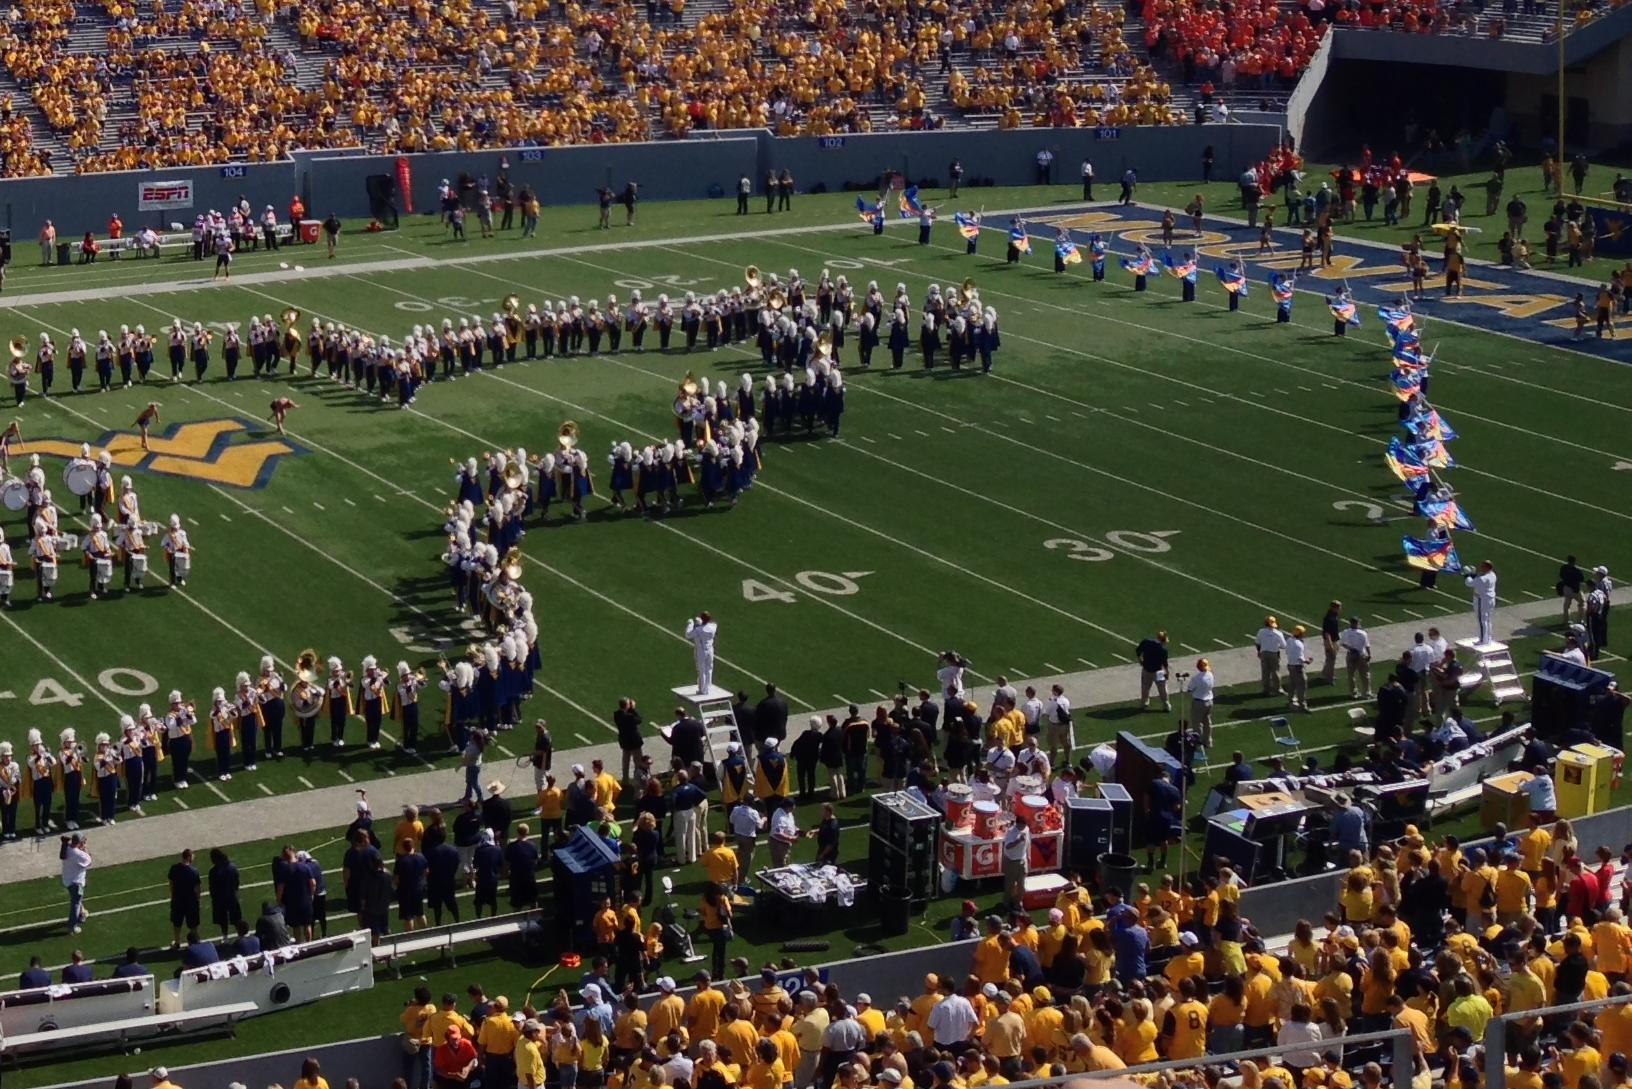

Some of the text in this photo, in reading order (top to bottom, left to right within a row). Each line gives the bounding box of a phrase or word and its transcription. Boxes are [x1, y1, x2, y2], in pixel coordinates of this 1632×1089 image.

[224, 166, 244, 177] 104
[143, 186, 189, 201] ESPN
[1043, 530, 1172, 562] 30
[742, 570, 860, 603] 40
[28, 667, 160, 707] 40
[975, 844, 994, 866] G
[1189, 1010, 1200, 1030] 8
